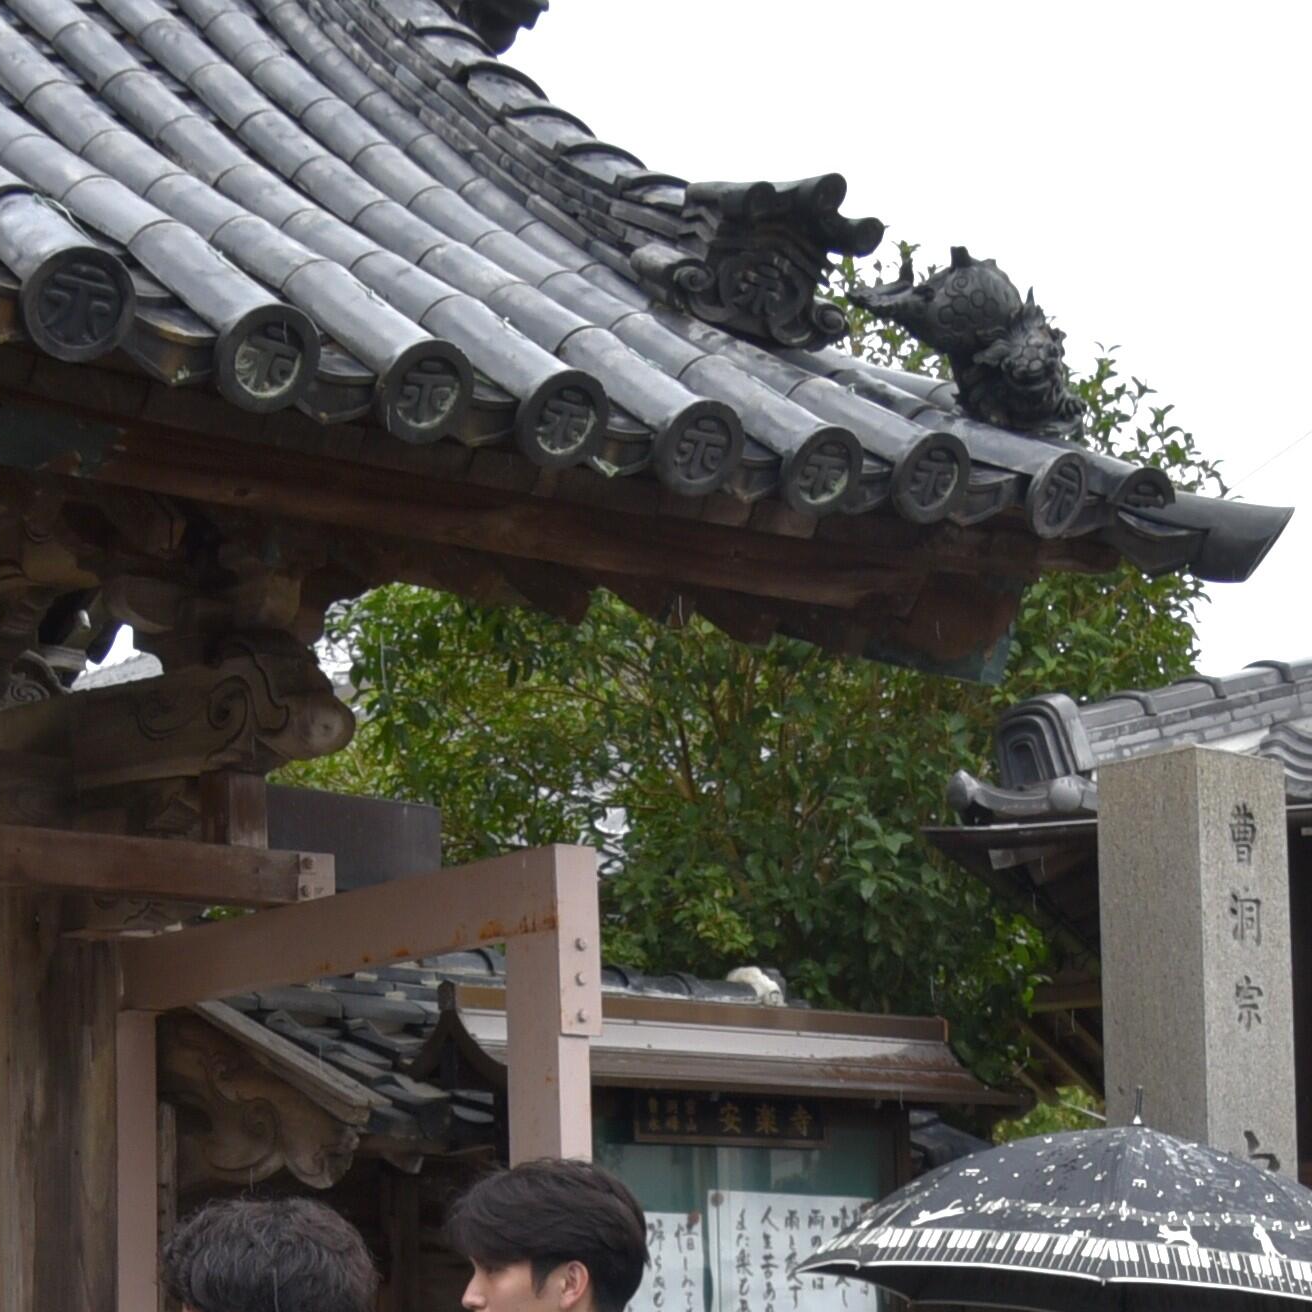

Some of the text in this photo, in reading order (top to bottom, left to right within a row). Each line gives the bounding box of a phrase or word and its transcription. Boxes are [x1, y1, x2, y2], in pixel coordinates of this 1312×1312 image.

[1228, 803, 1264, 1030] 曹洞宗
[807, 1208, 825, 1290] 雨のは
